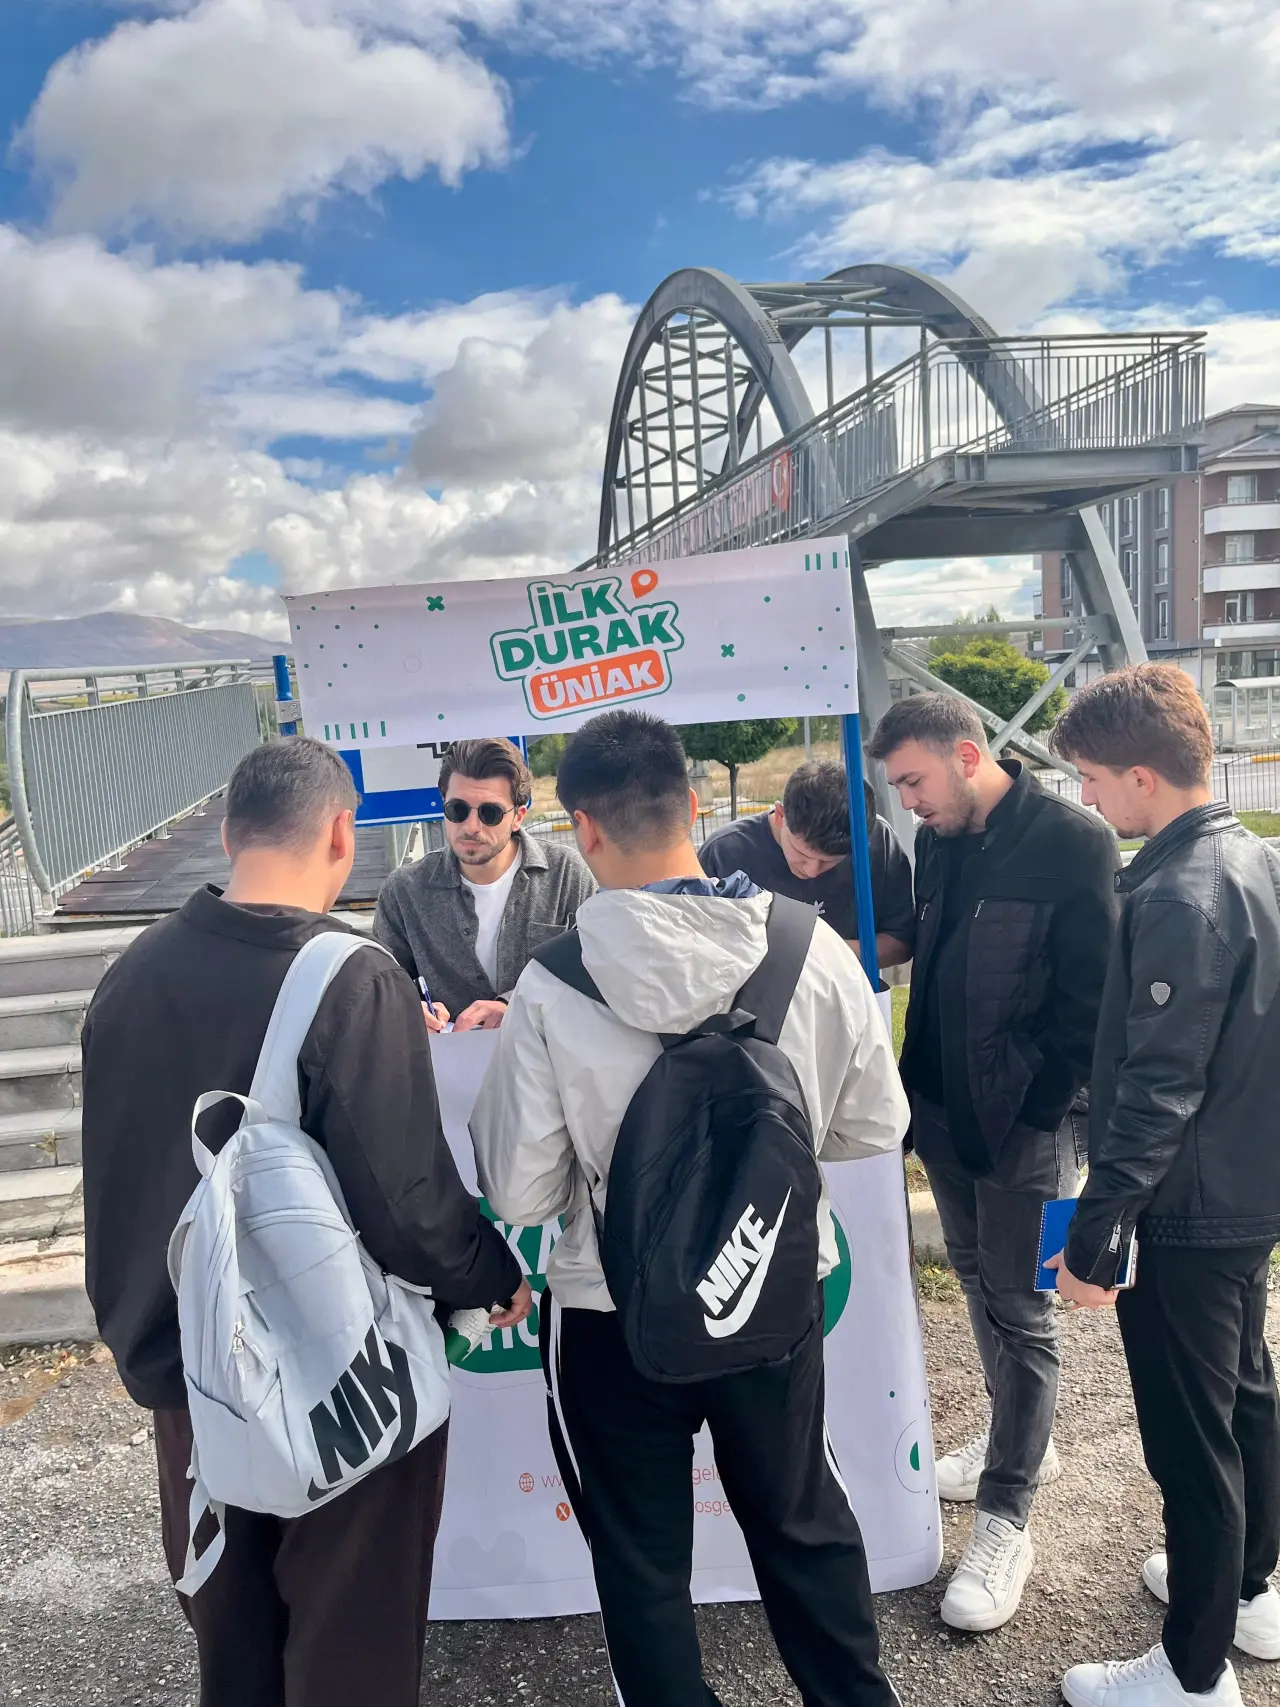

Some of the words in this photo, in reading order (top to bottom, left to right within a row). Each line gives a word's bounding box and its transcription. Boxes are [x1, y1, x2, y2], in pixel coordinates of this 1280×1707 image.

[537, 583, 618, 627] İLK
[499, 610, 676, 672] DURAK
[540, 660, 657, 708] ÜNİAK
[695, 1203, 774, 1316] NIKE
[308, 1323, 403, 1485] NIK
[1000, 1544, 1021, 1592] VALENTINO
